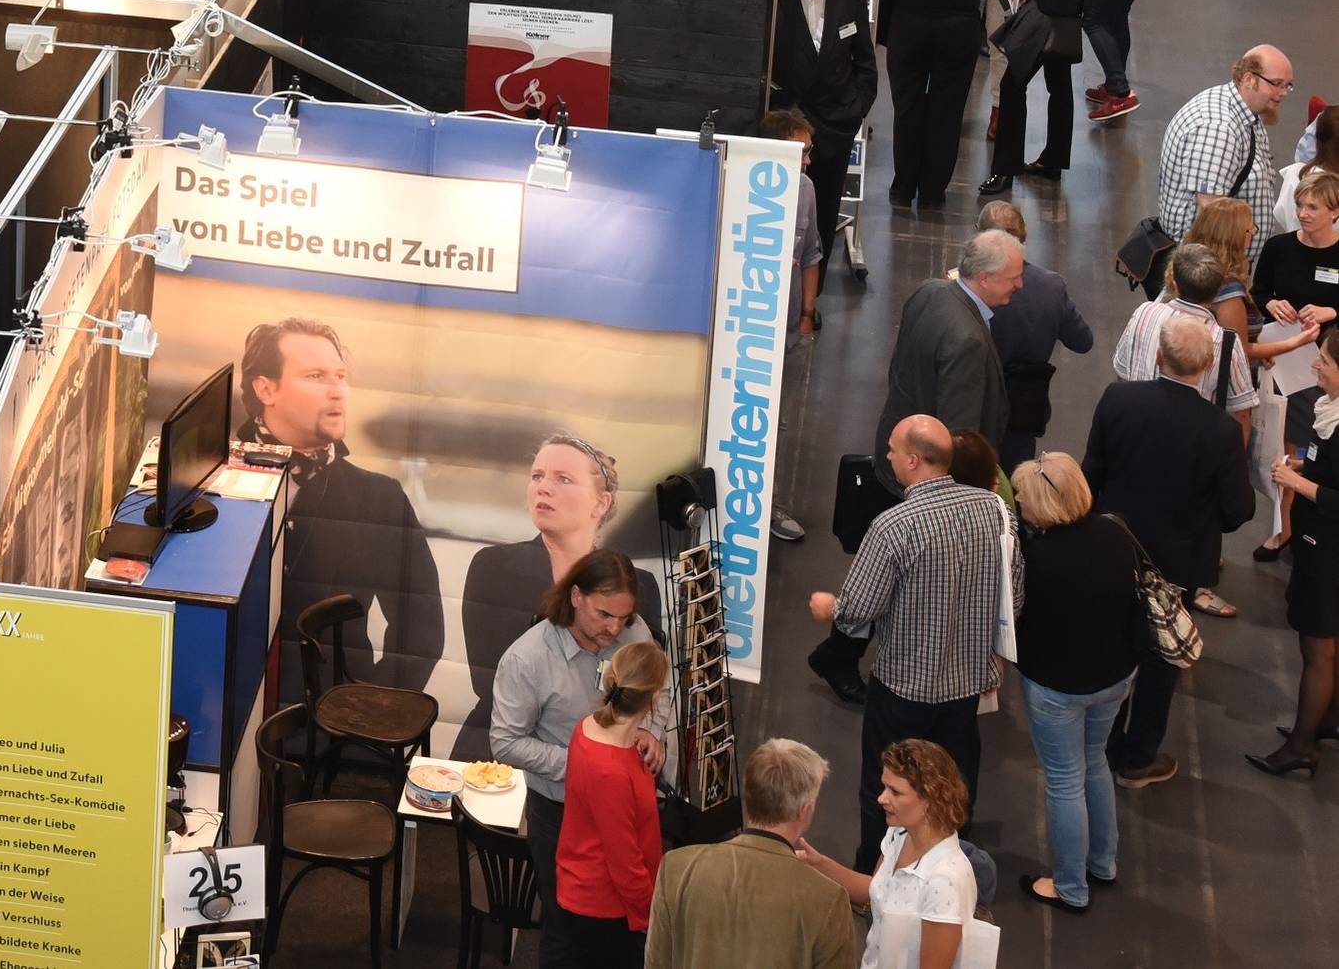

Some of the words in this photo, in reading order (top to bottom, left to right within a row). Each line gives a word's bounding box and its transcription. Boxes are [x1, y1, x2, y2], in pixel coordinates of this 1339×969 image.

[175, 166, 230, 197] Das
[240, 175, 318, 208] Spiel
[172, 217, 228, 242] von
[238, 219, 324, 255] Liebe
[333, 238, 392, 263] und
[400, 239, 495, 273] Zufall
[16, 738, 37, 750] und
[39, 742, 65, 754] Julia
[12, 764, 43, 776] Liebe
[46, 768, 67, 780] und
[70, 772, 103, 784] Zufall
[23, 816, 42, 826] der
[45, 818, 76, 831] Liebe
[13, 839, 50, 853] sieben
[53, 844, 96, 859] Meeren
[13, 864, 49, 877] Kampf
[9, 888, 28, 899] der
[30, 890, 65, 904] Weise
[2, 912, 61, 929] Verschluss
[42, 942, 82, 956] Kranke
